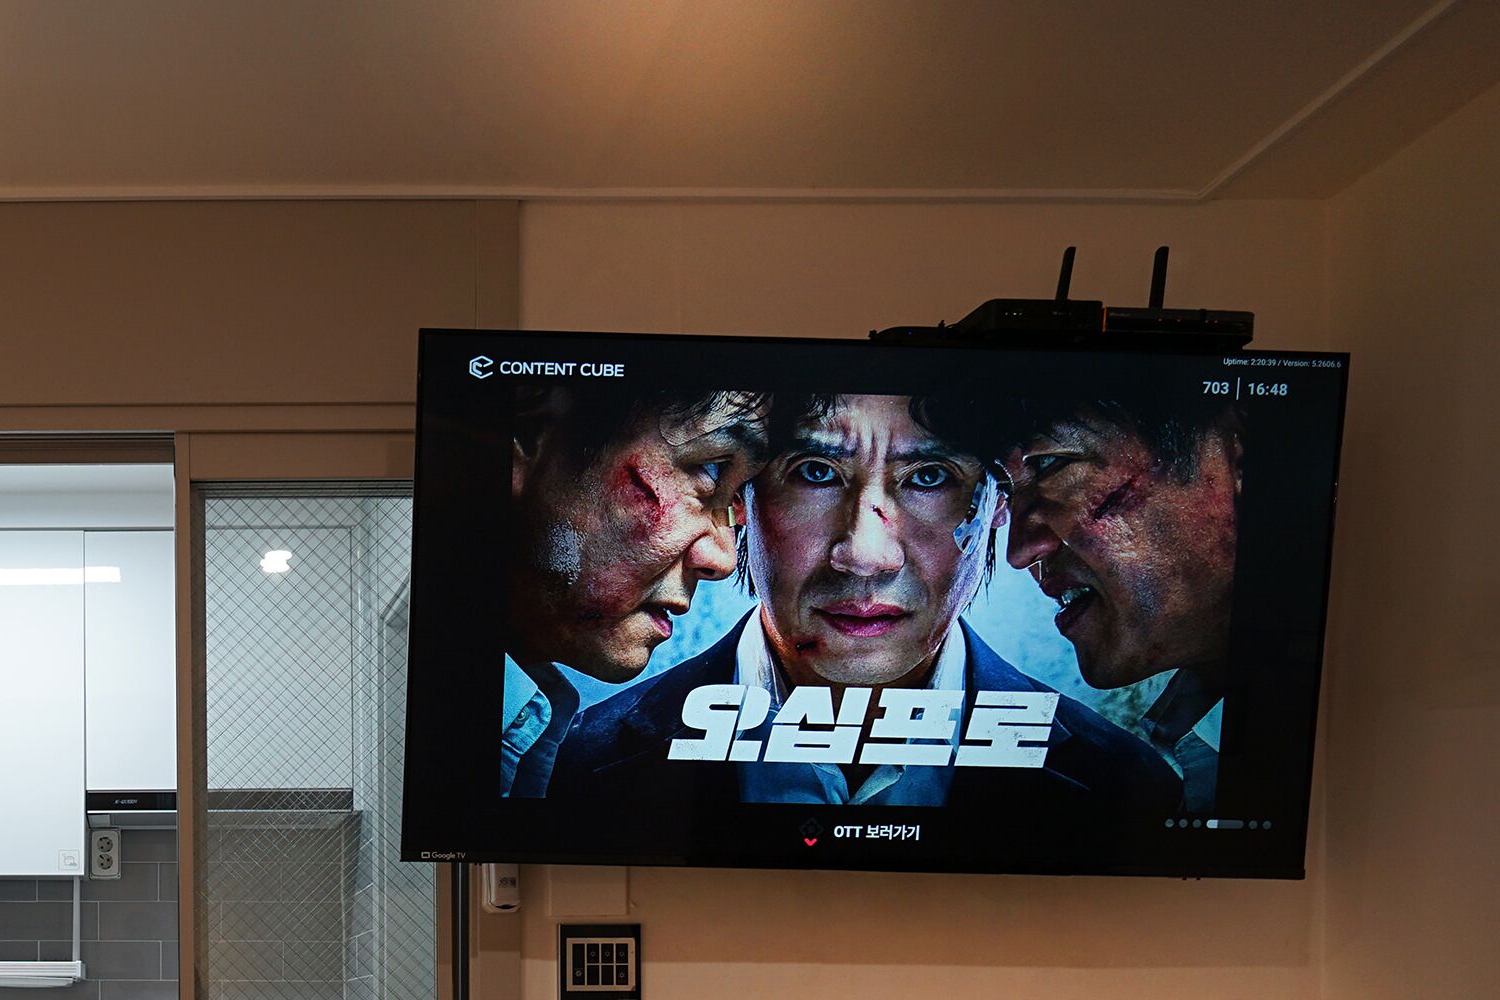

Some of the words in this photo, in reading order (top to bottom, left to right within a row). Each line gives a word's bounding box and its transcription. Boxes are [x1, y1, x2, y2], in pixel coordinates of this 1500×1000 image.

[500, 361, 577, 376] CONTENT
[580, 362, 625, 377] CUBE
[1202, 381, 1230, 395] 703
[1248, 382, 1288, 396] 16:48
[667, 684, 1060, 768] 오십프로
[834, 825, 864, 838] OTT
[865, 824, 920, 841] 보러가기
[432, 851, 456, 861] Google
